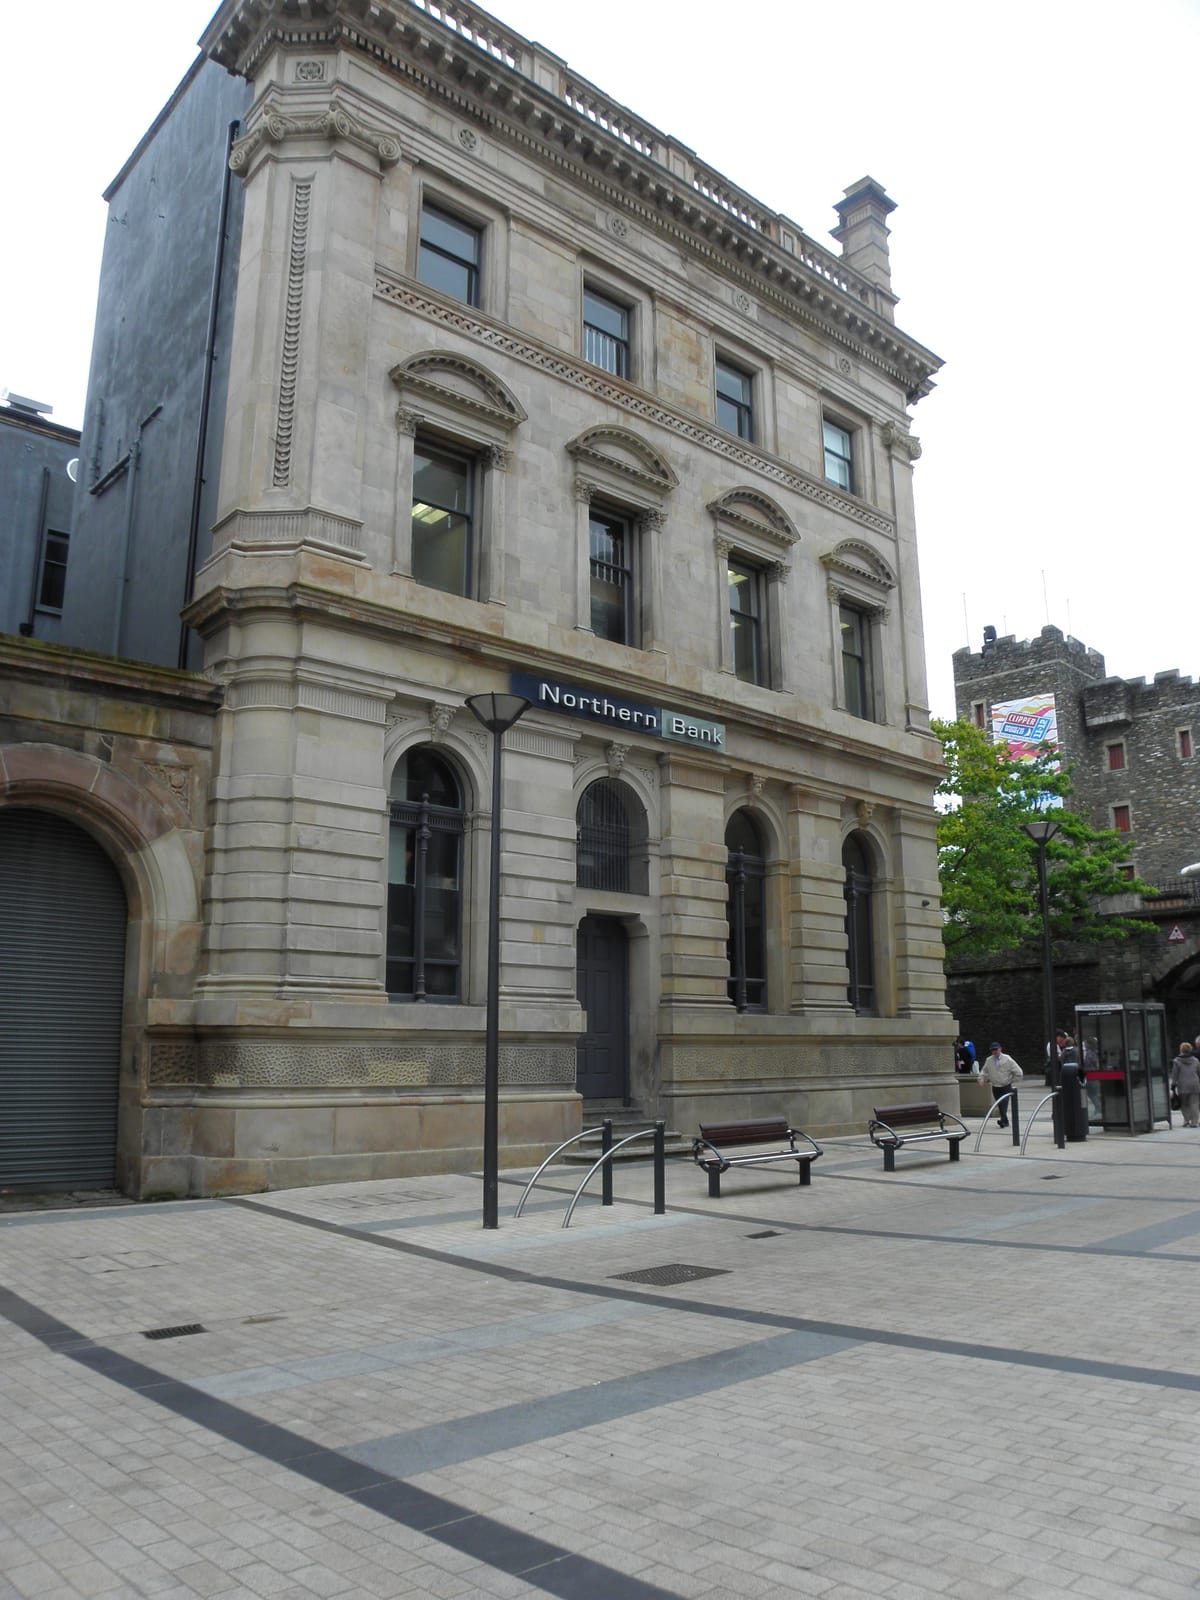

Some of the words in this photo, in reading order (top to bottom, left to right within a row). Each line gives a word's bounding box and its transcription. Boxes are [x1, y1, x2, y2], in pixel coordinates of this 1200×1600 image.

[539, 682, 657, 728] Northern
[672, 718, 723, 745] Bank
[1008, 713, 1036, 726] CLIPPER
